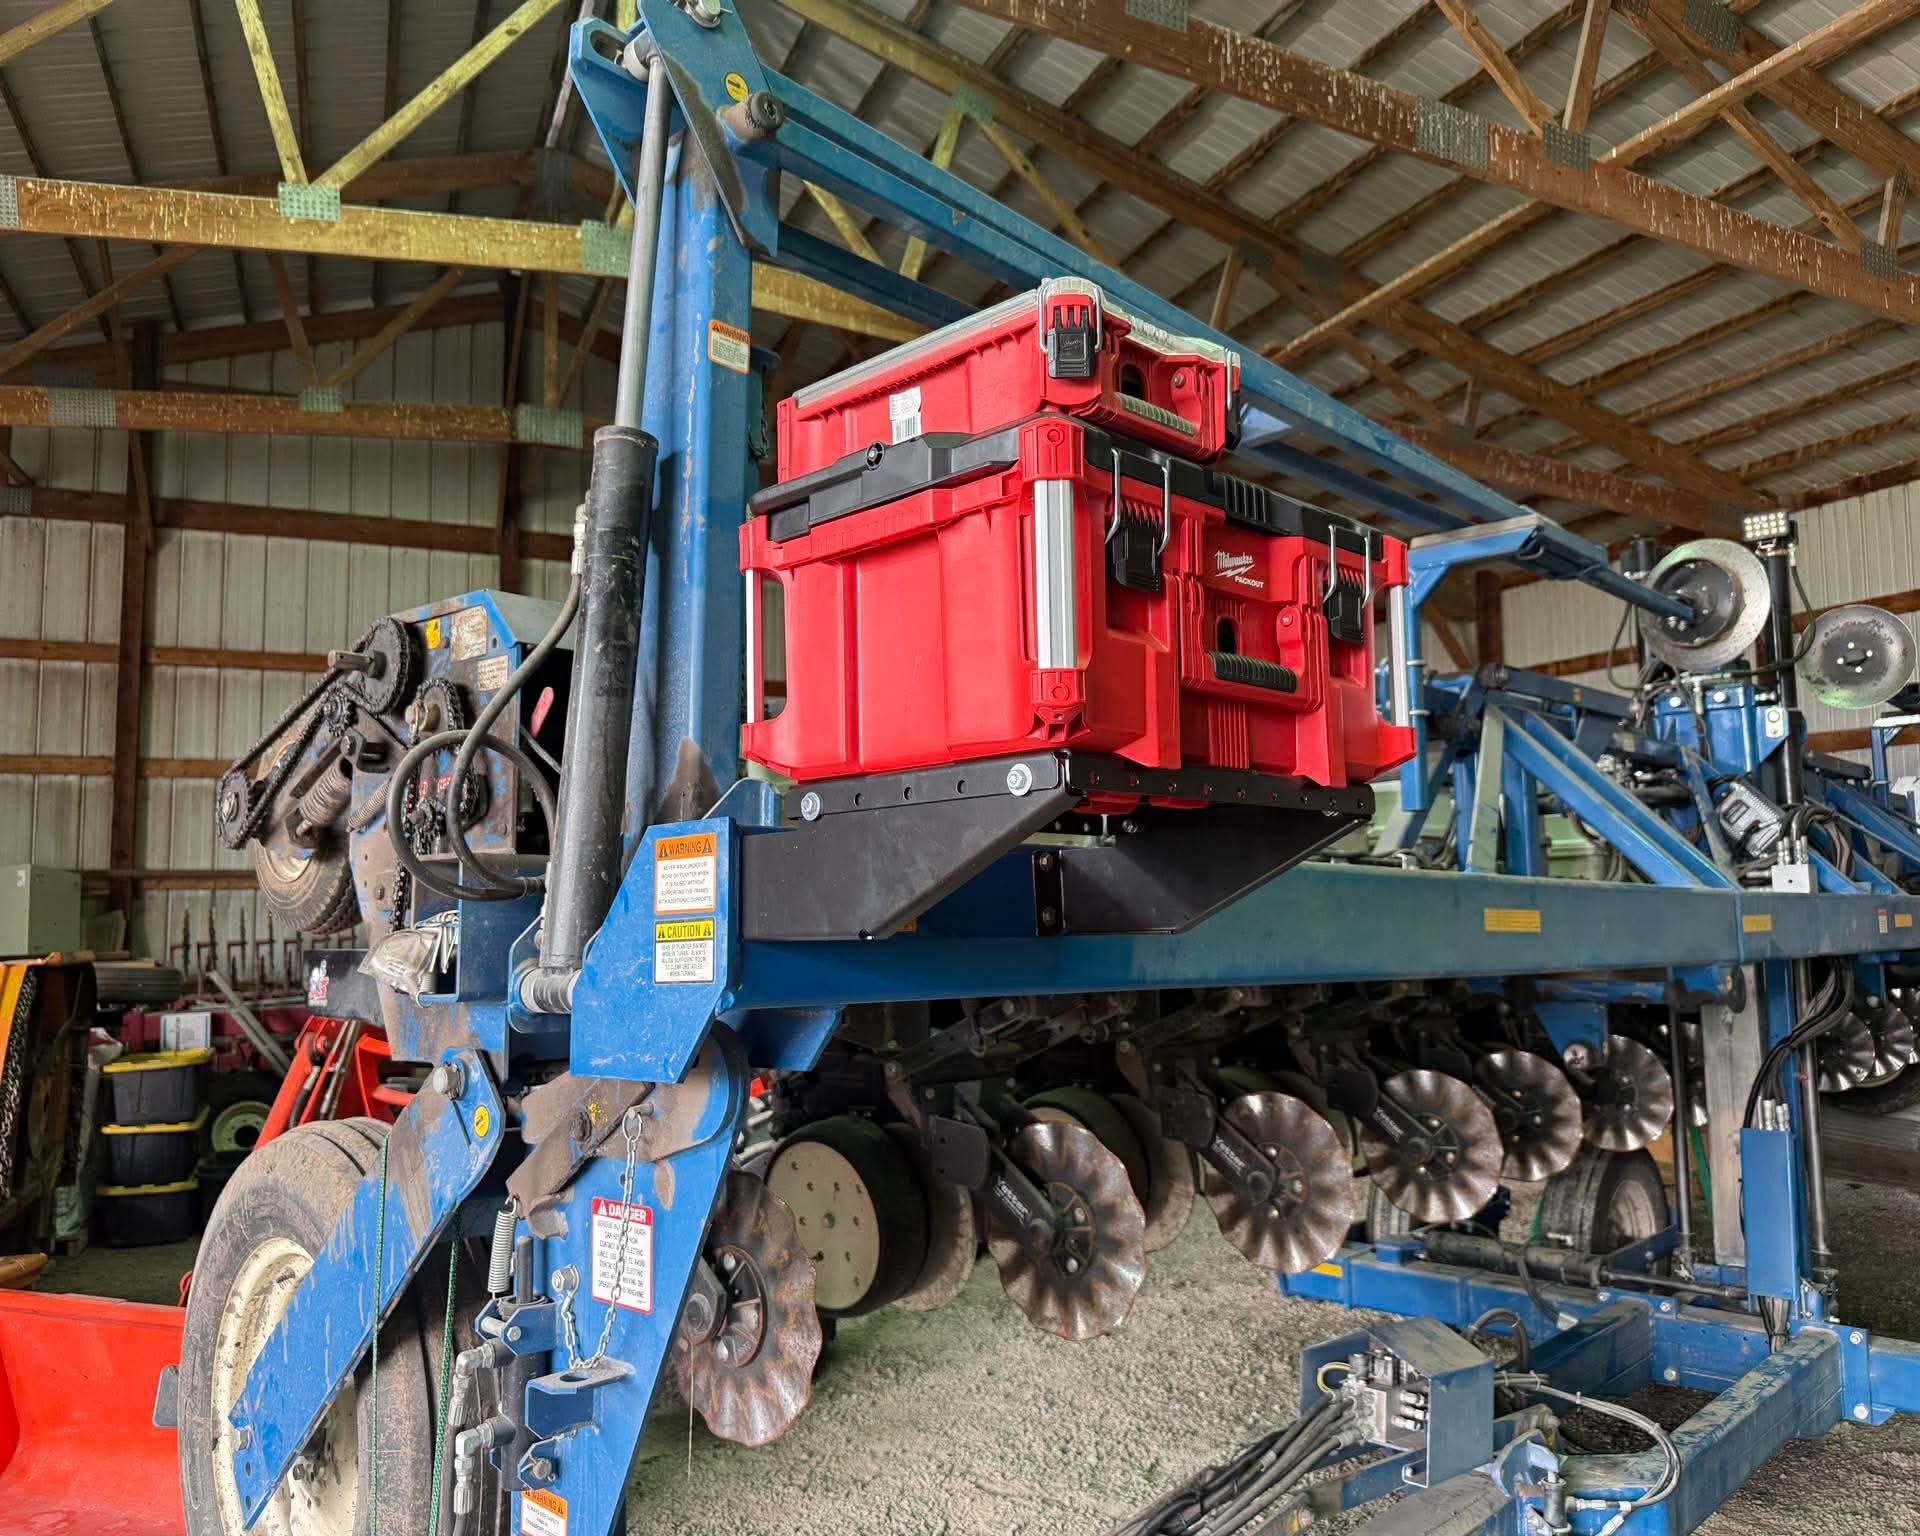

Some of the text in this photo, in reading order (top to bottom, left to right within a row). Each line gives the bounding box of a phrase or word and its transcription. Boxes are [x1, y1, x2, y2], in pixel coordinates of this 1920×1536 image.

[1214, 550, 1254, 570] Milwaukee
[1234, 575, 1264, 589] PACKOUT
[668, 841, 702, 856] WARNING
[667, 924, 701, 939] CAUTION
